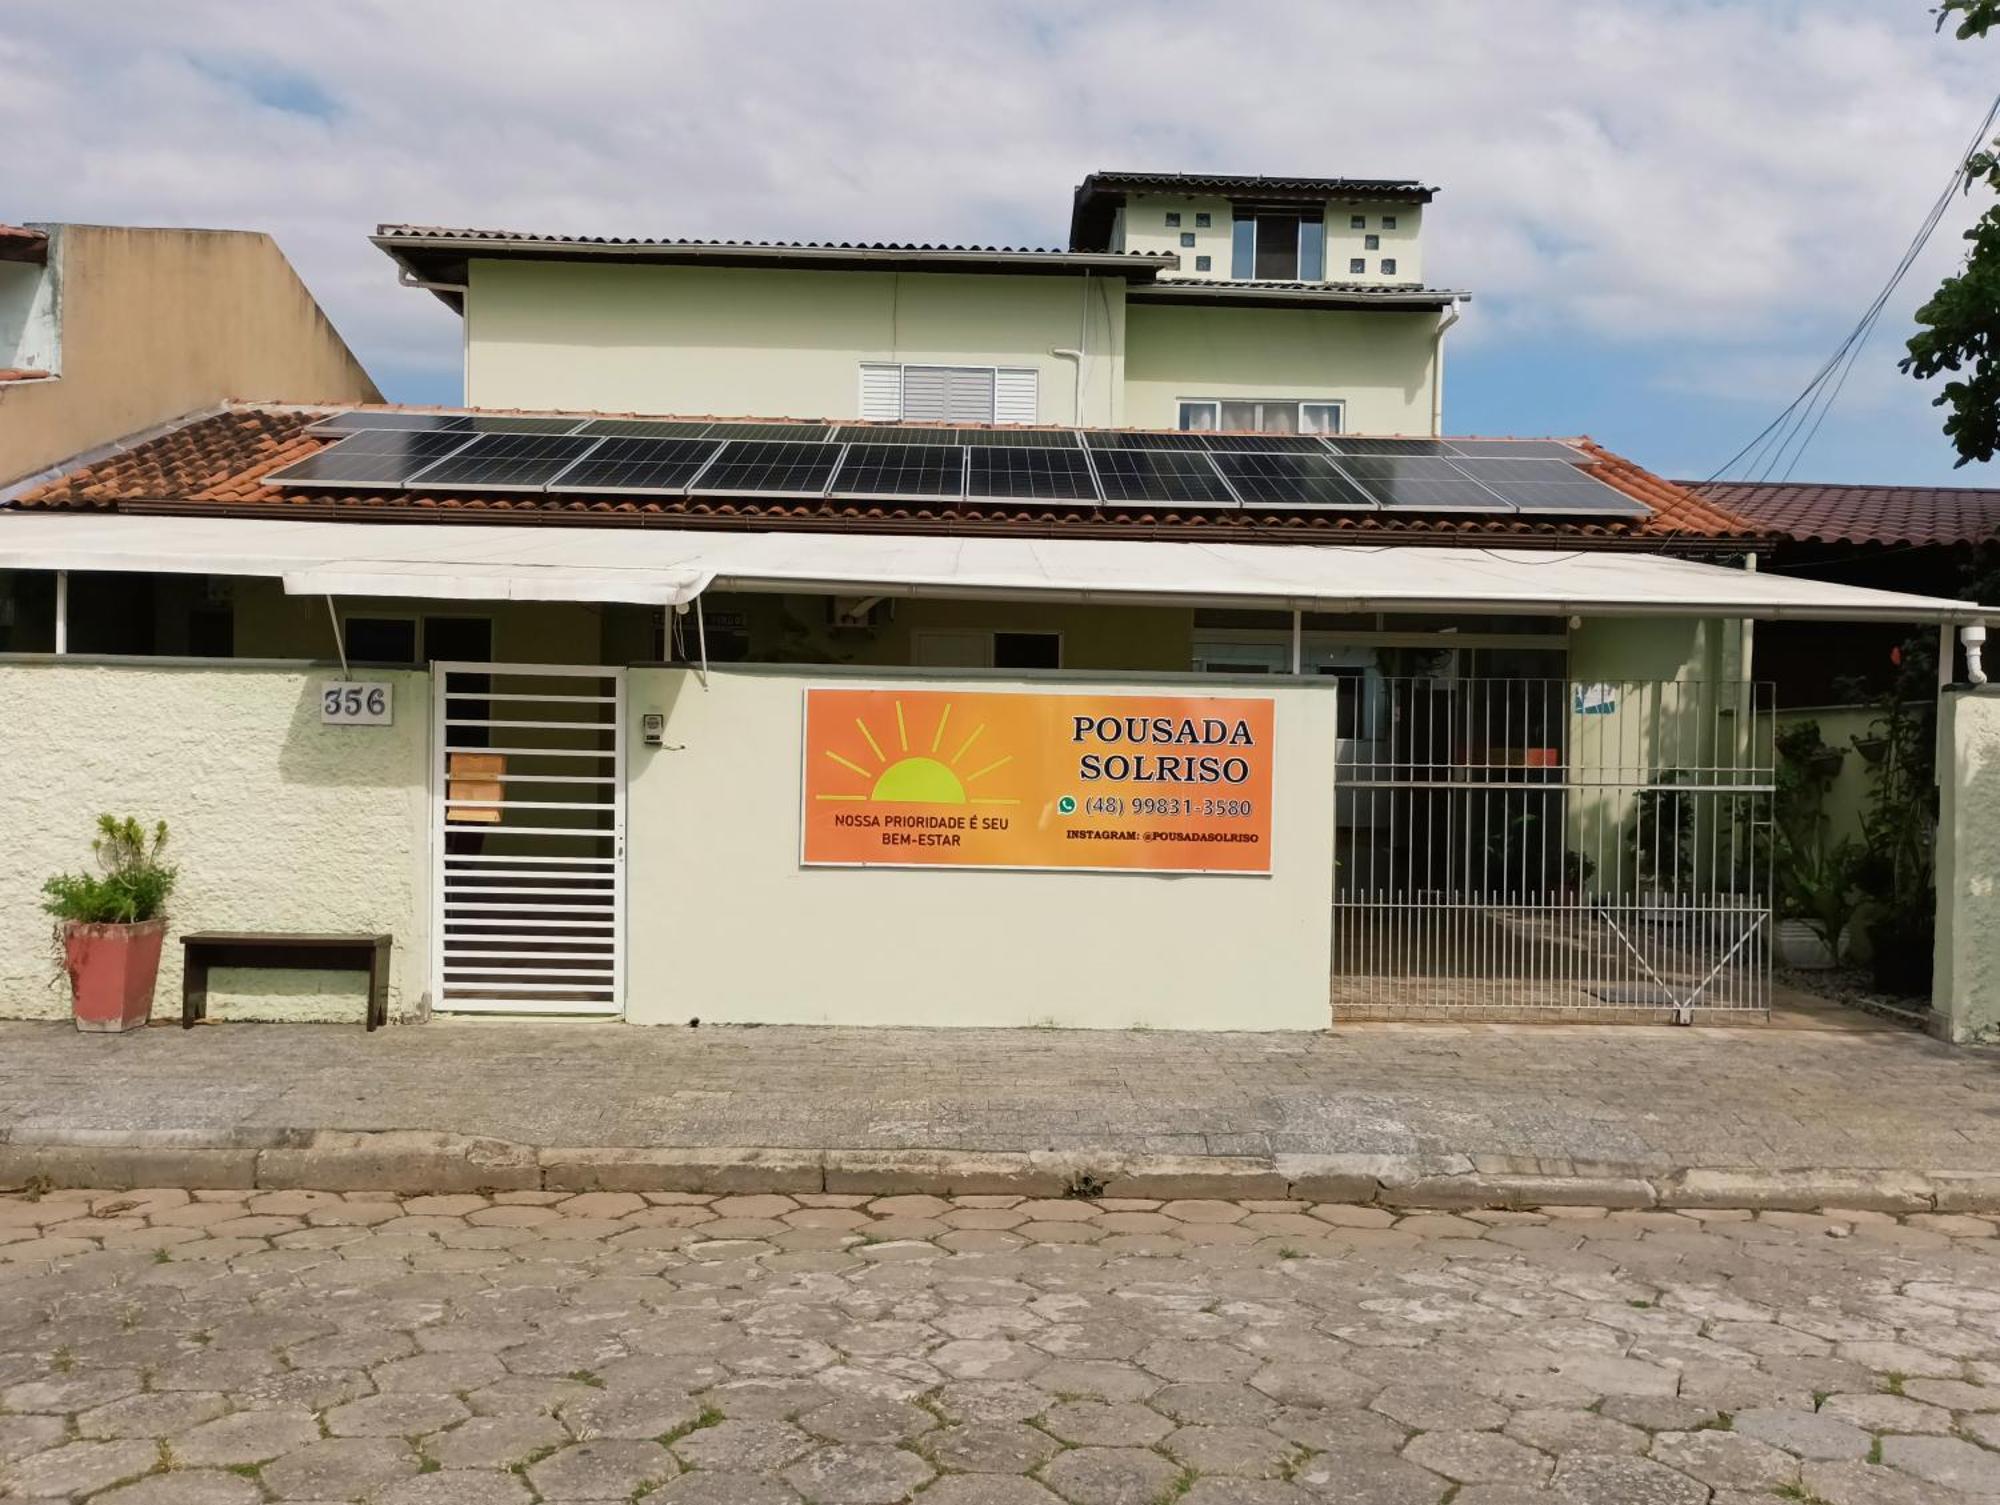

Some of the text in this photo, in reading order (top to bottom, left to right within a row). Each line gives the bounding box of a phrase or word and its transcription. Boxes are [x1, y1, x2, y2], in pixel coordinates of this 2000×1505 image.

[325, 686, 385, 715] 356
[1073, 716, 1253, 745] POUSADA
[1080, 755, 1249, 783] SOLRISO
[1085, 797, 1252, 816] (48) 99831-3580
[835, 815, 1009, 830] NOSSA PRIORIDADE É SEU
[882, 833, 961, 846] BEM-ESTAR
[1066, 830, 1259, 843] INSTAGRAM: @POUSADASOLRISO
